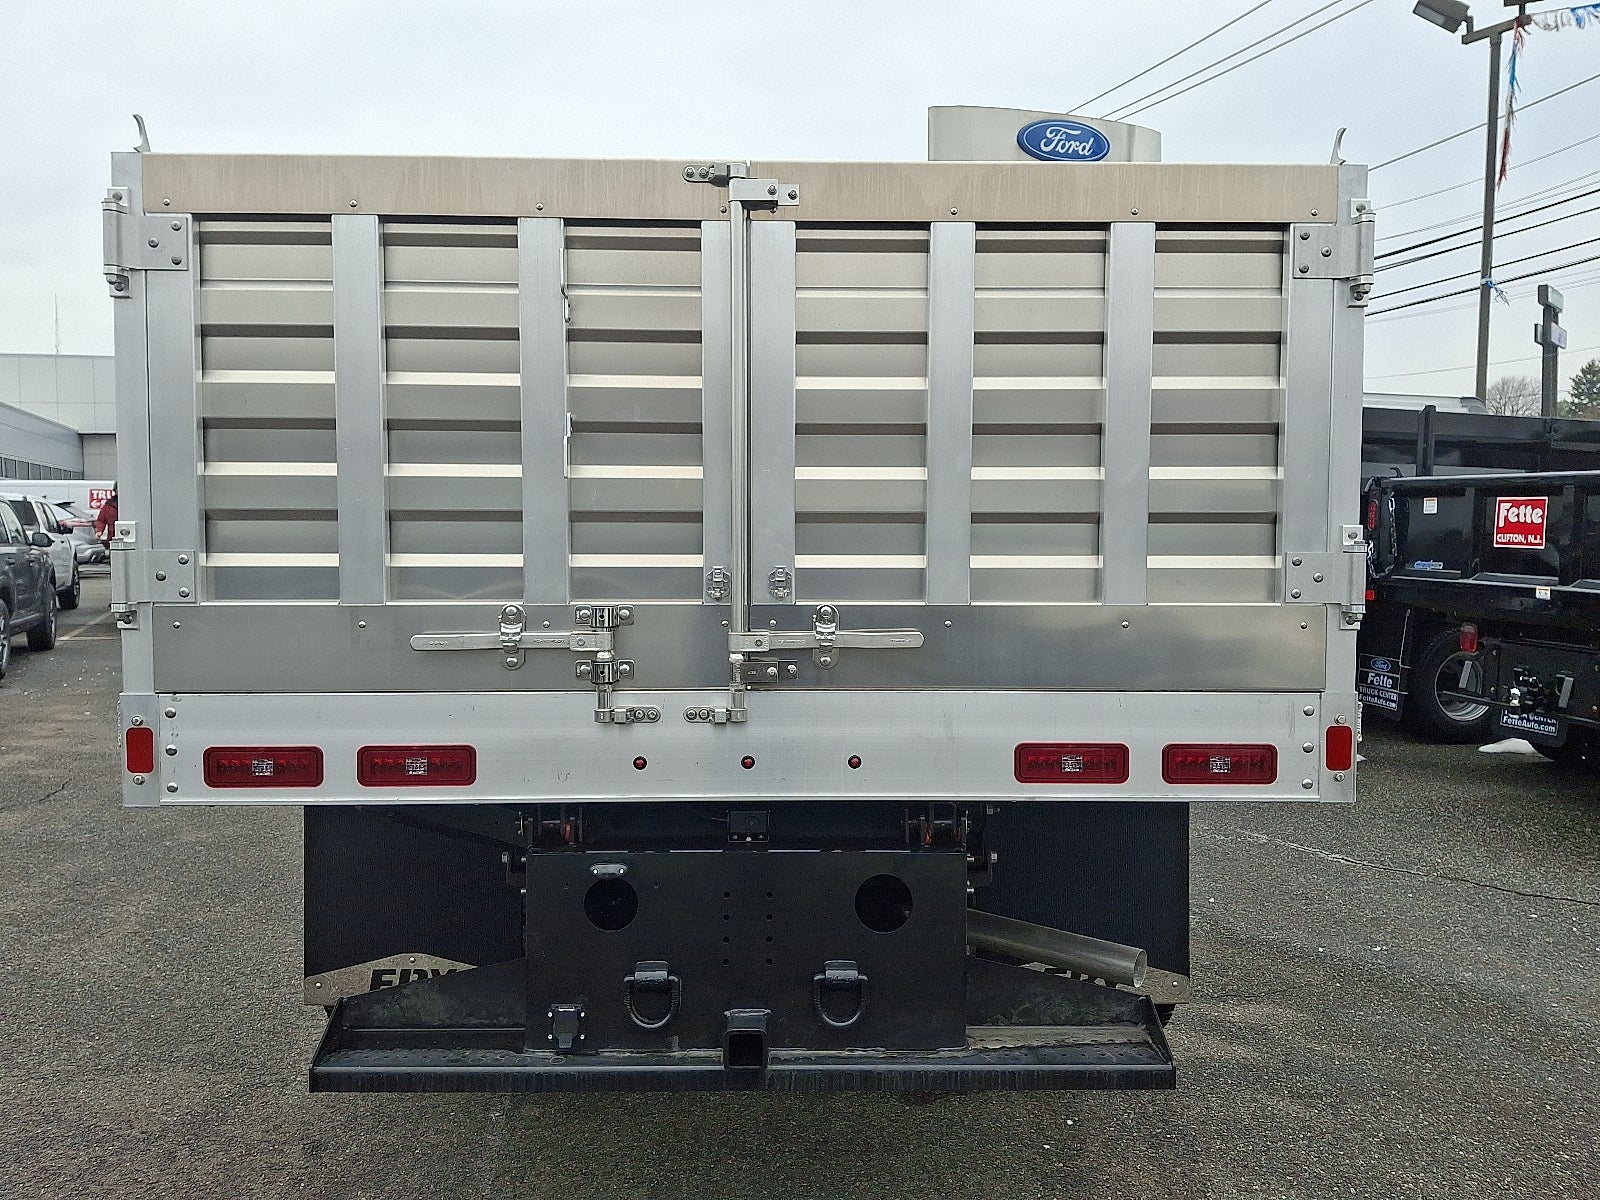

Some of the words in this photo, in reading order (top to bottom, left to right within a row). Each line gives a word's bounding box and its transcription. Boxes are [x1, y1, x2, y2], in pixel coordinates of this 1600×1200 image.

[1040, 127, 1094, 156] Ford
[1498, 502, 1543, 528] Fette
[1527, 534, 1542, 544] N.J.
[1367, 672, 1393, 688] Fette
[1359, 685, 1379, 696] TRUCK
[1503, 715, 1556, 733] FetteAuto.com
